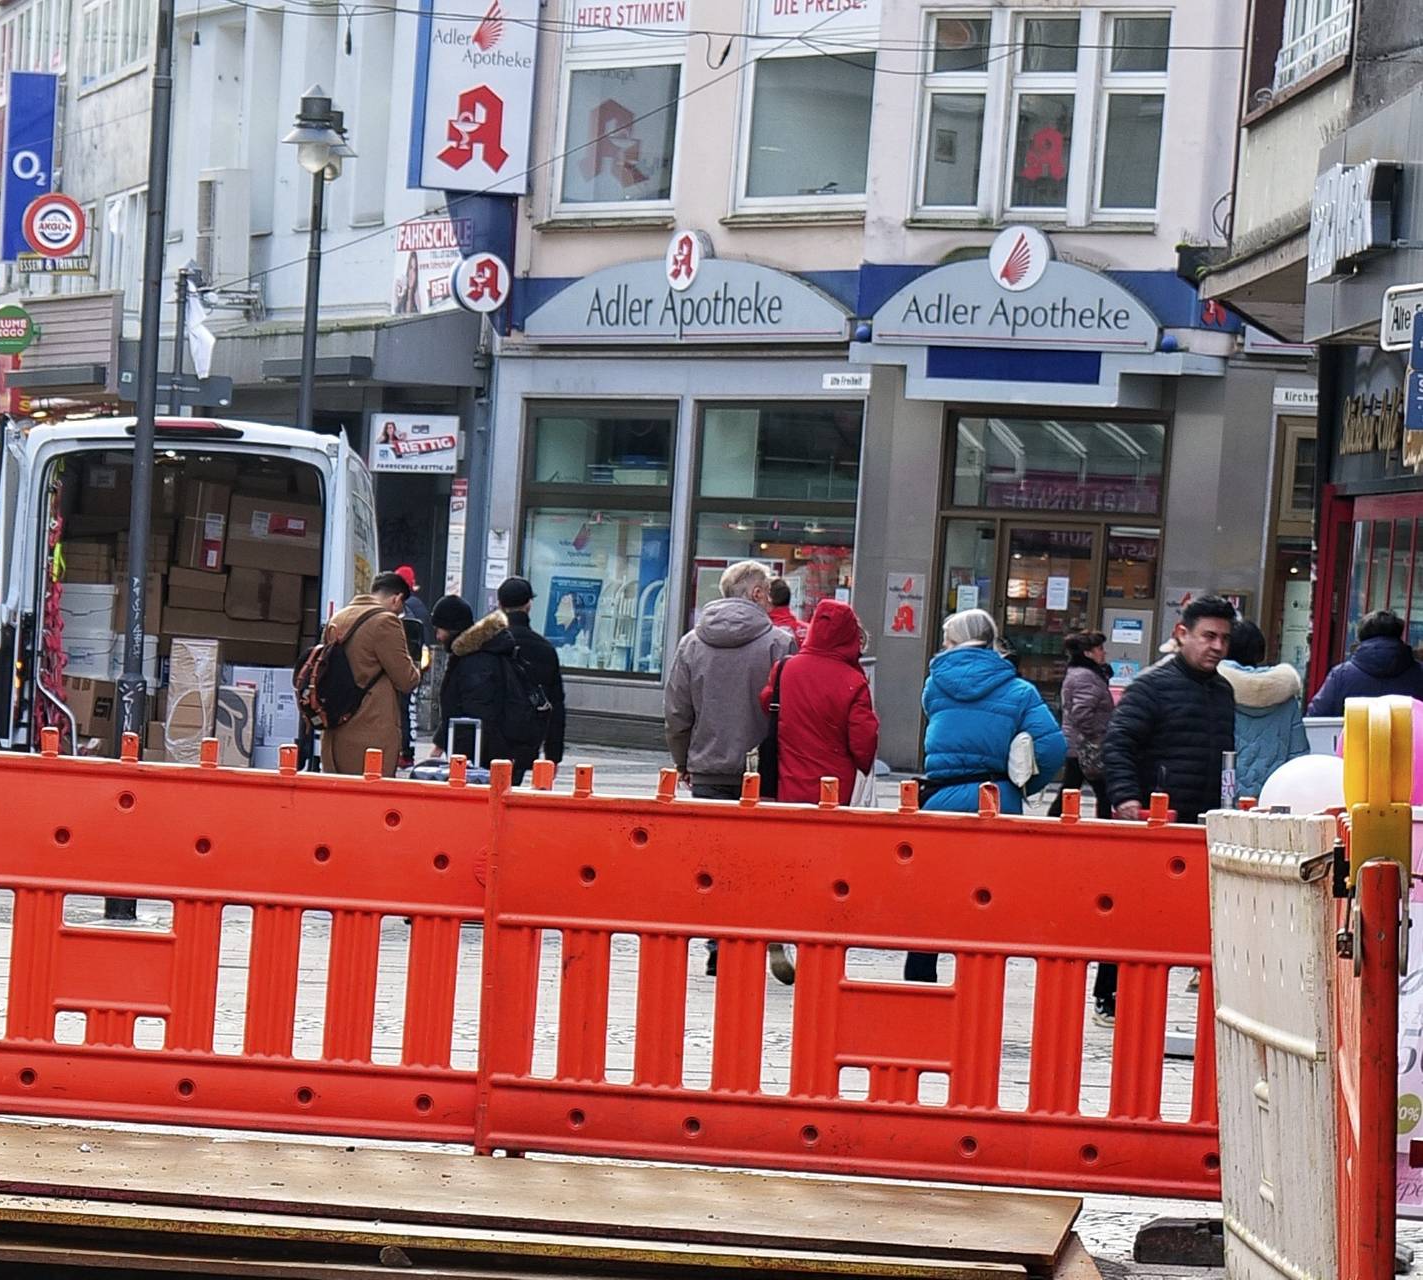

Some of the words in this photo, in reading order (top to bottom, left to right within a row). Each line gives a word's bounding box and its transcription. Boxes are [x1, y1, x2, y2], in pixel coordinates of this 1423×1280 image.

[578, 7, 611, 28] HIER
[616, 2, 685, 26] STIMMEN
[433, 28, 471, 46] Adler
[462, 49, 531, 69] Apotheke
[19, 259, 43, 271] ESSEN
[55, 258, 89, 270] TRINKEN
[586, 284, 653, 326] Adler
[659, 281, 782, 340] Apotheke
[902, 293, 981, 325] Adler
[989, 297, 1130, 337] Apotheke
[1391, 306, 1411, 331] Alte
[398, 437, 452, 453] RETTIG
[1398, 1106, 1419, 1122] 0%
